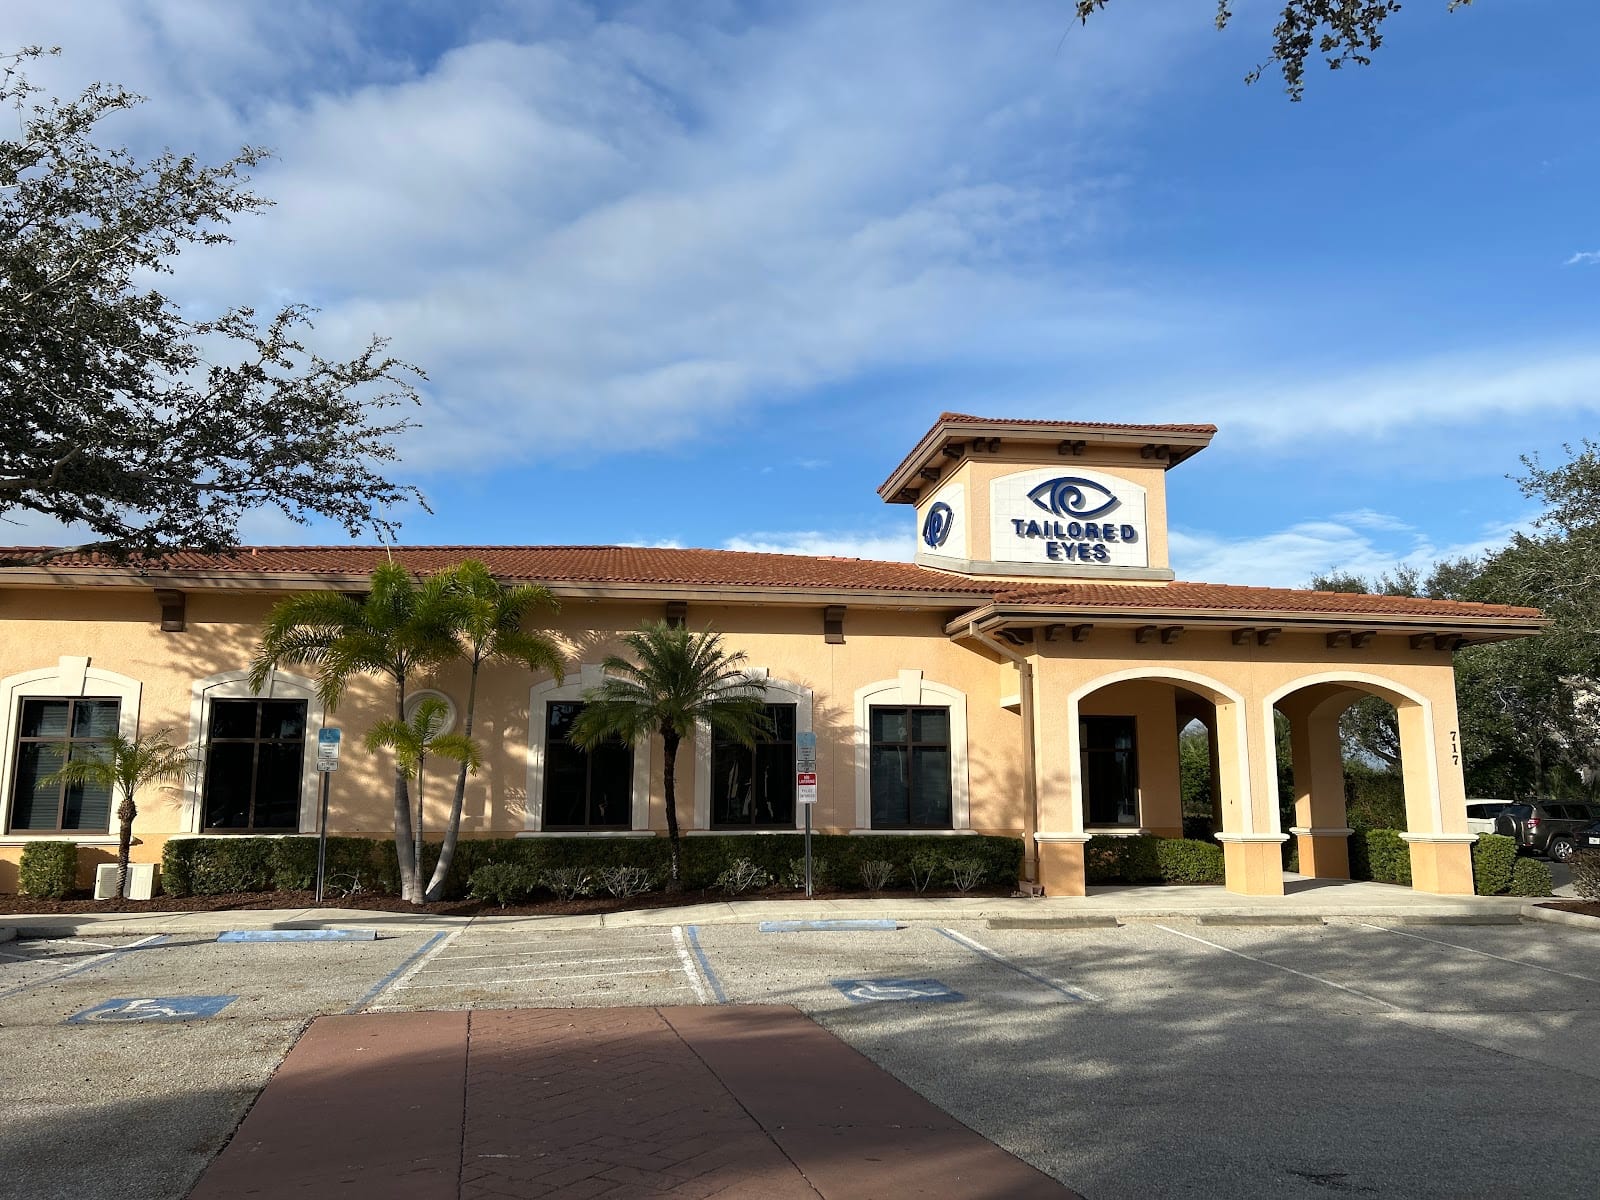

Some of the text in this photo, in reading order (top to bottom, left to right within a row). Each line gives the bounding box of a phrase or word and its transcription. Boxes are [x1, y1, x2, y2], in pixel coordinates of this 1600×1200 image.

[1010, 518, 1137, 542] TAILORED
[1046, 541, 1109, 562] EYES
[1450, 731, 1459, 766] 717
